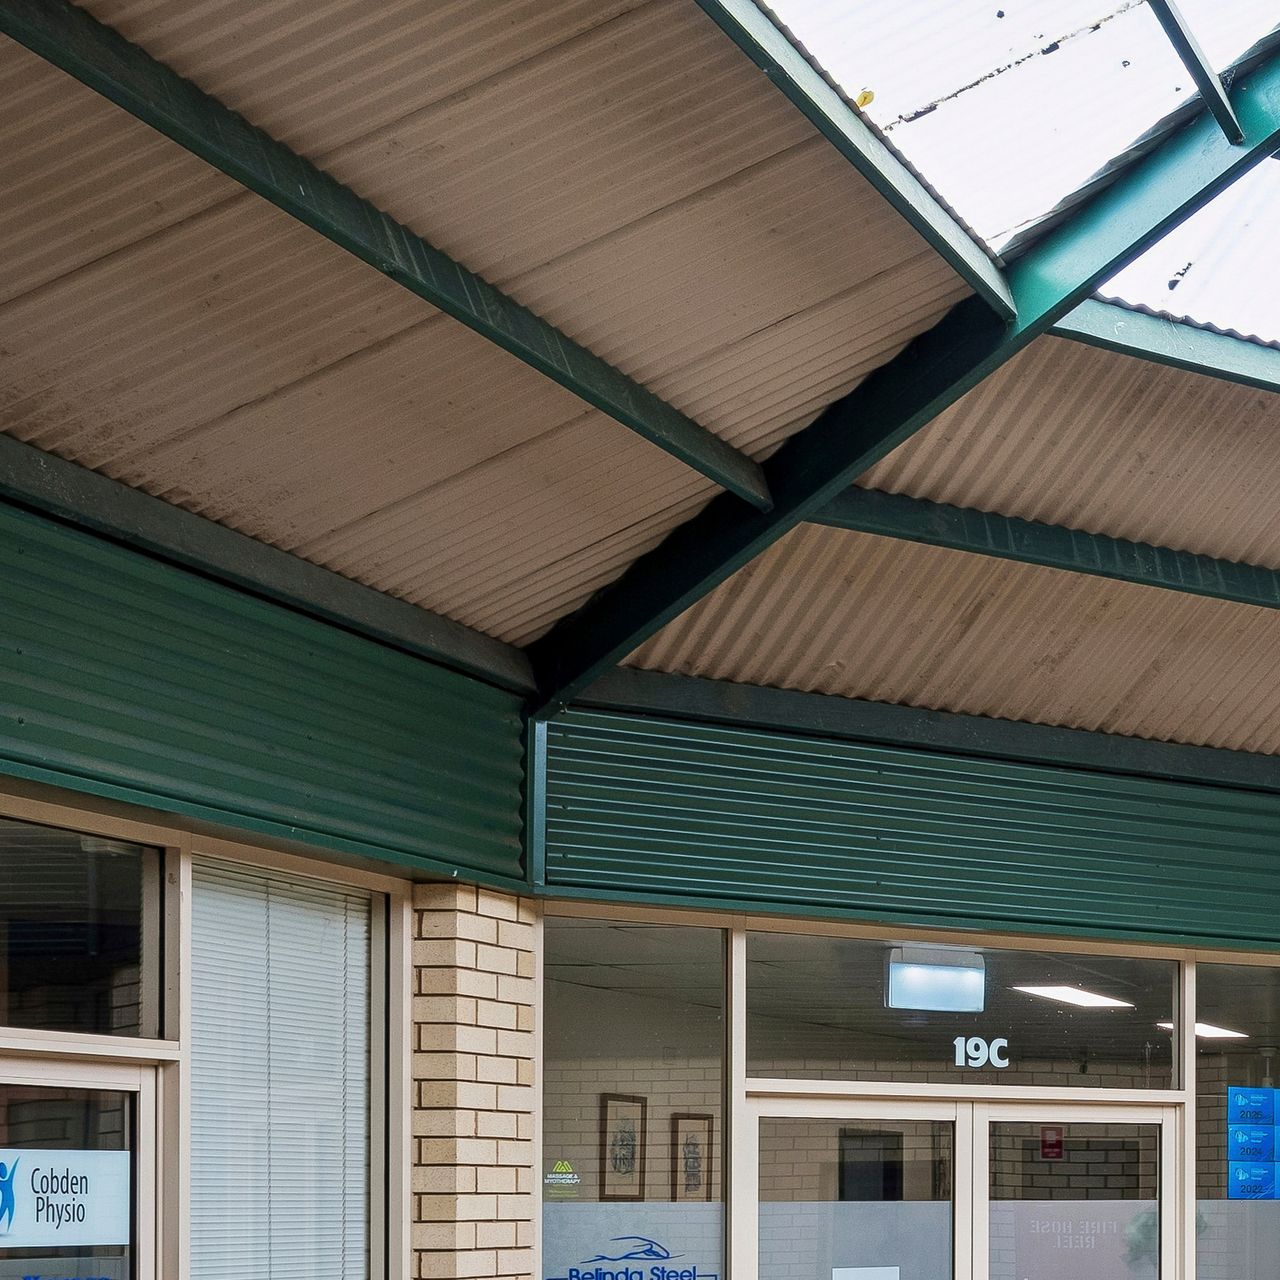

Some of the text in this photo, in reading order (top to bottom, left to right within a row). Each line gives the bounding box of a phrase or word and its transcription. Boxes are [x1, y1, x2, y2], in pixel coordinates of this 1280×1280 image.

[953, 1036, 1010, 1068] 19C
[31, 1167, 89, 1195] Cobden
[36, 1195, 86, 1230] Physio
